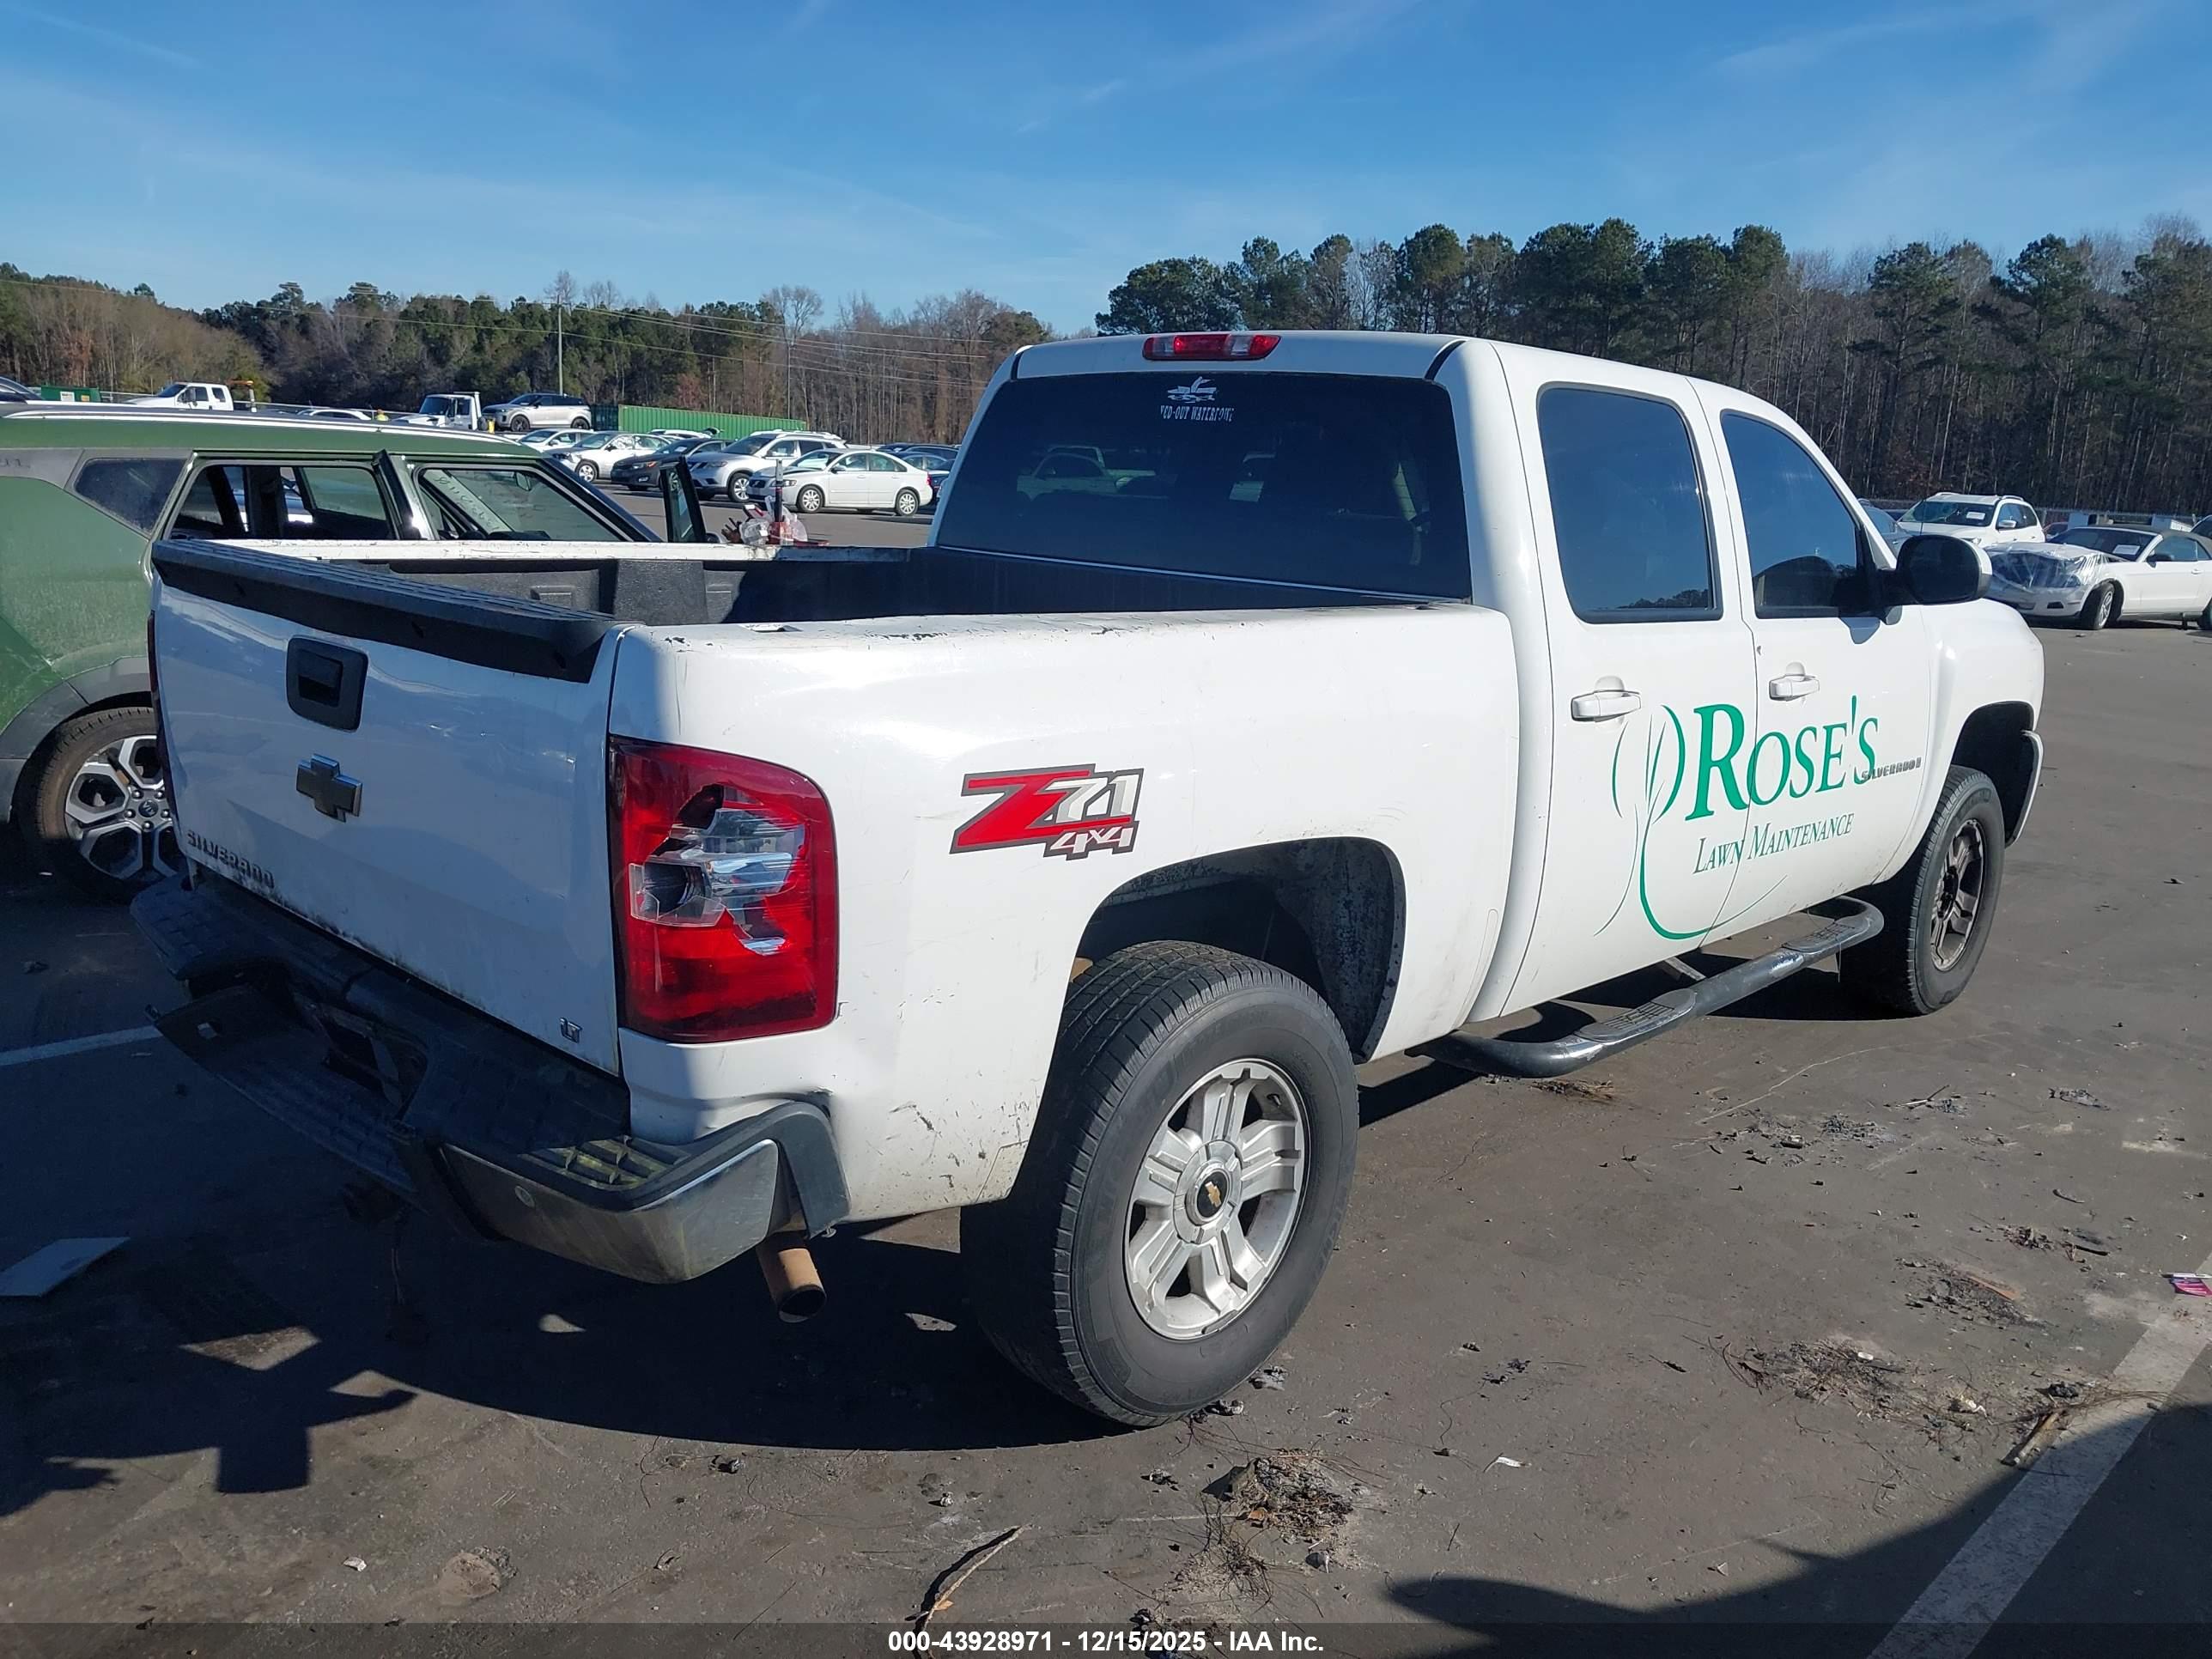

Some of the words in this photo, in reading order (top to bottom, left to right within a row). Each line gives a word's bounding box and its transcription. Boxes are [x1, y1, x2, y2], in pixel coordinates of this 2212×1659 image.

[1685, 695, 1879, 822] ROSE'S
[951, 763, 1144, 854] Z71
[1692, 837, 1746, 874] LAWN
[1747, 812, 1855, 860] MAINTENANCE
[186, 830, 276, 890] SILVERADO
